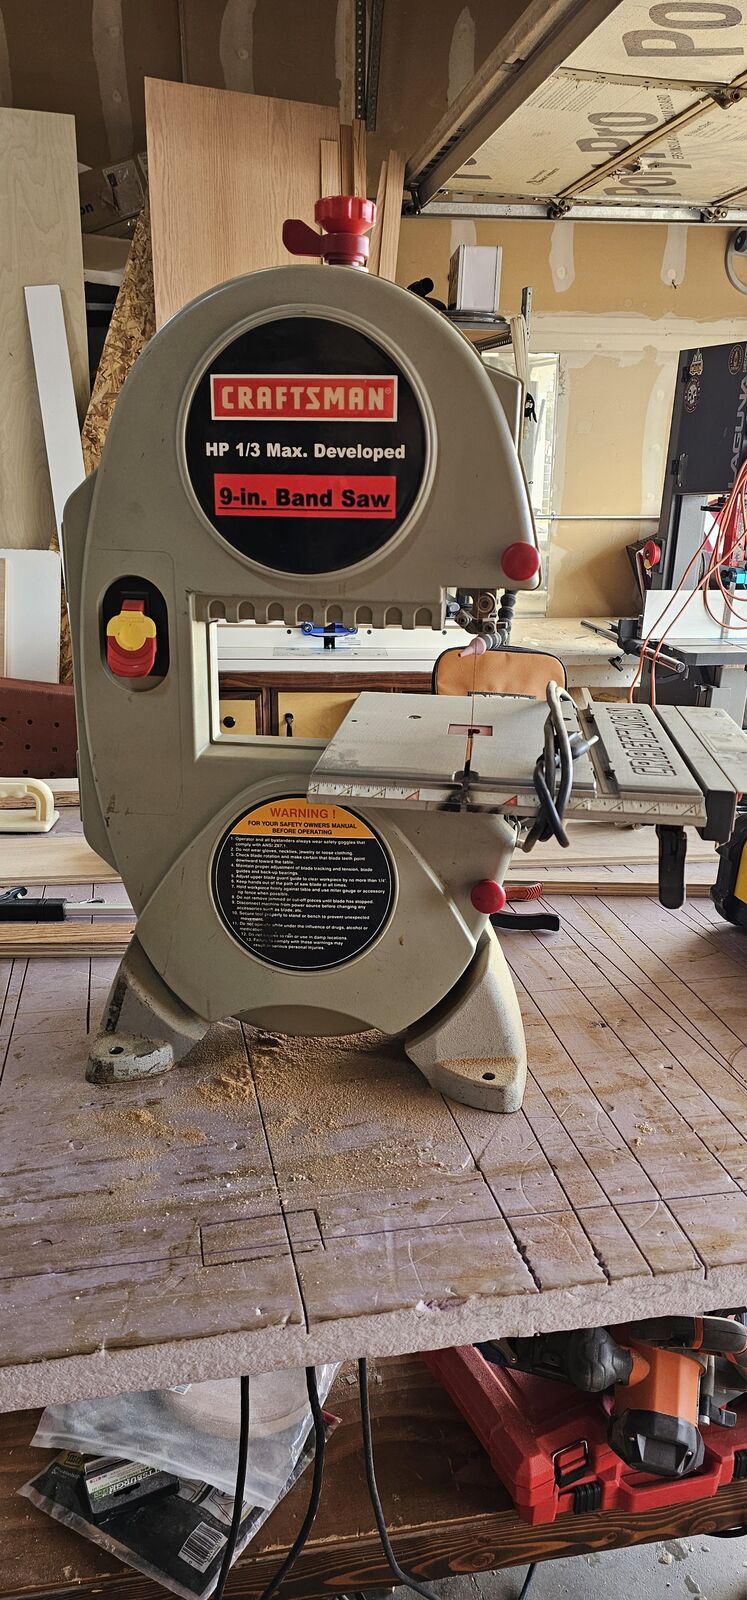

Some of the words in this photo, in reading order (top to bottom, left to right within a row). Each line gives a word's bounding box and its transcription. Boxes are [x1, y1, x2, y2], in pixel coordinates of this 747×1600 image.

[205, 442, 230, 457] HP
[235, 442, 261, 458] 1/3
[267, 443, 308, 458] Max.
[314, 444, 406, 462] Developed
[219, 487, 267, 506] 9-in.
[276, 488, 333, 507] Band
[341, 489, 390, 508] Saw
[605, 707, 678, 777] CRAFTSMAN
[270, 807, 329, 819] WARNING
